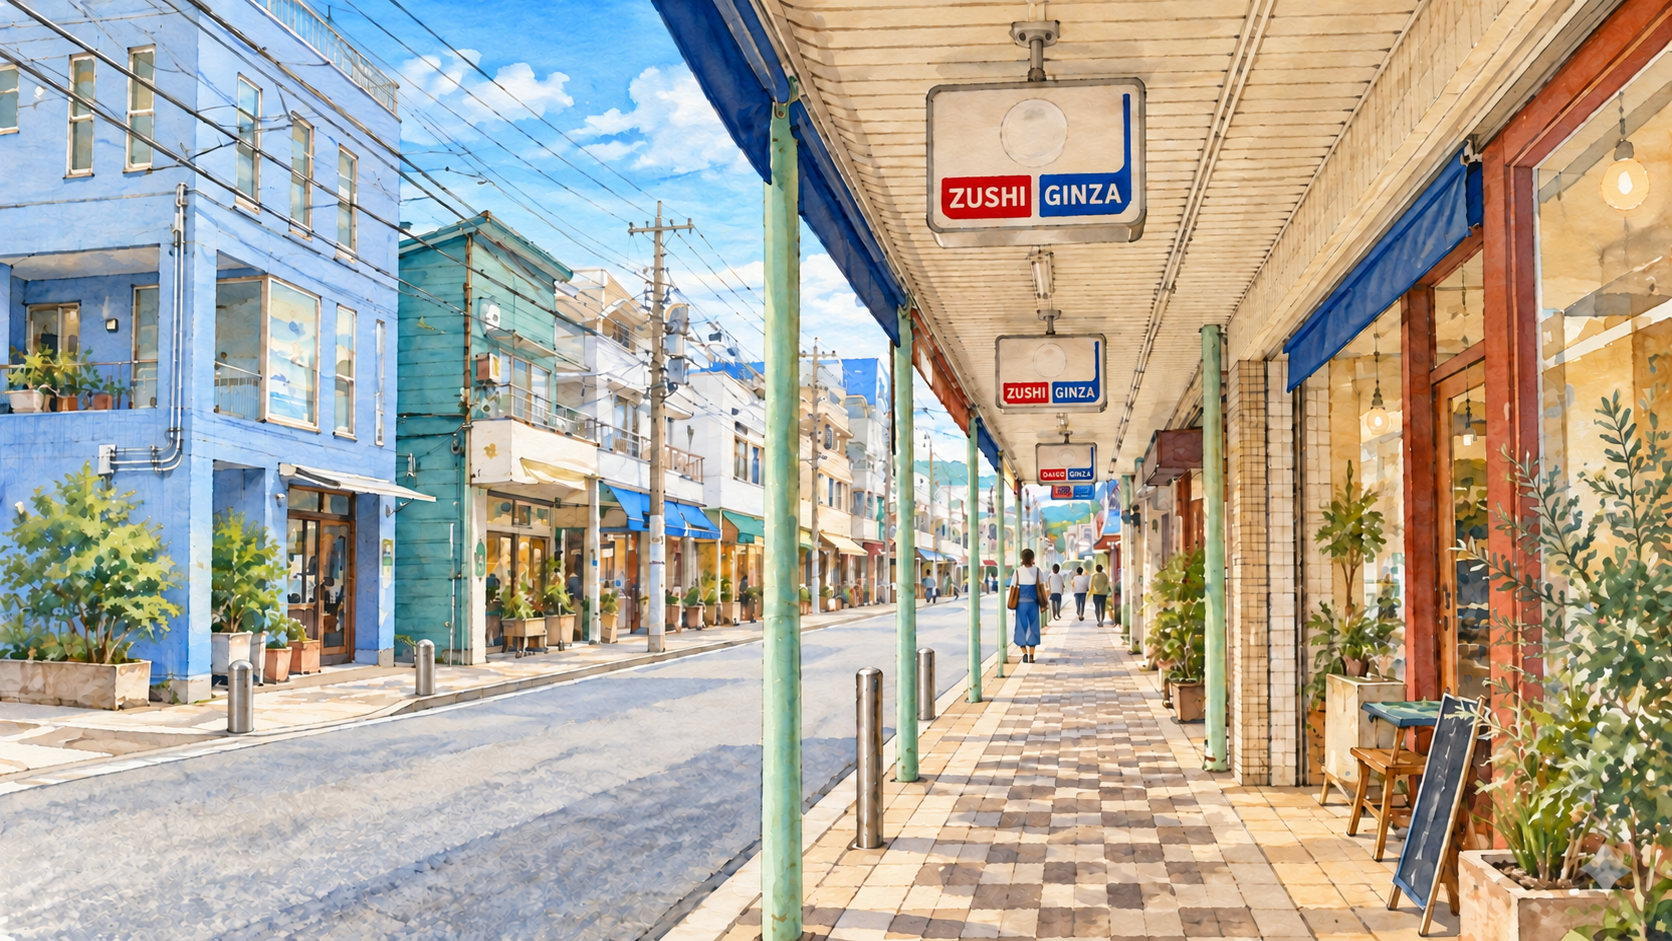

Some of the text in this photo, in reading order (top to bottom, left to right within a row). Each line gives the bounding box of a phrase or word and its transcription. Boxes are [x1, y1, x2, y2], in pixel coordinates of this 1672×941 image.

[948, 183, 1122, 209] ZUSHI GINZA
[1007, 387, 1095, 399] ZUSHI GINZA
[1069, 470, 1091, 478] GINZA
